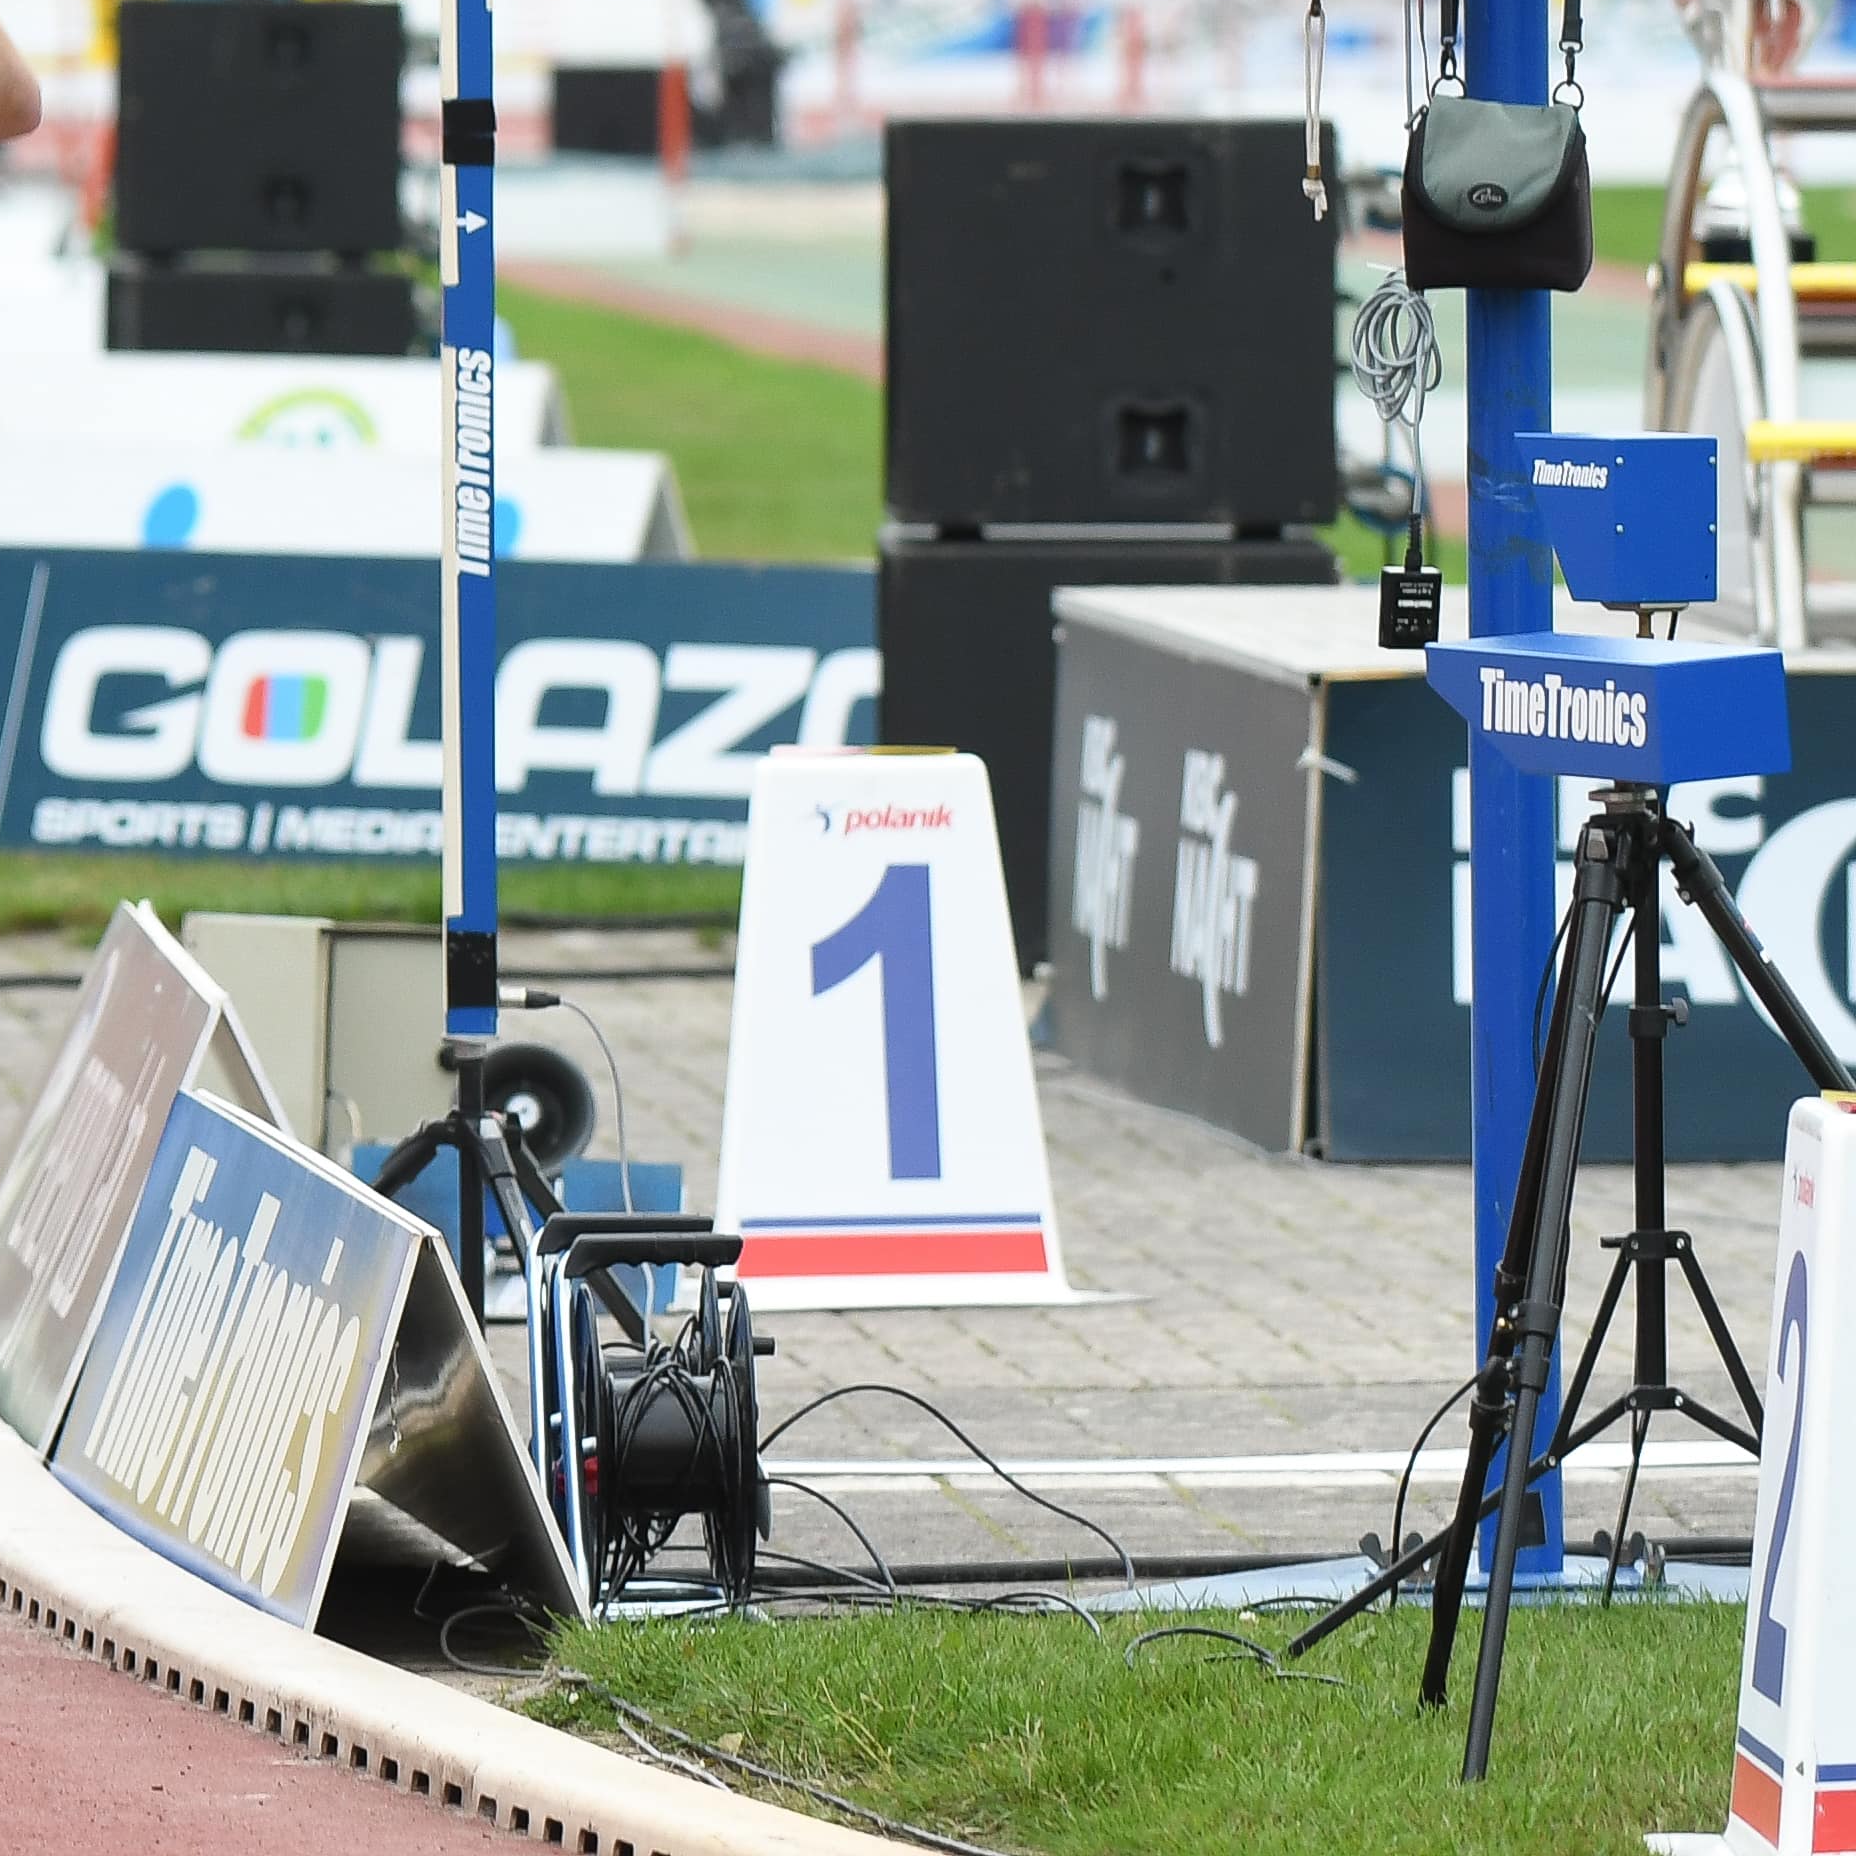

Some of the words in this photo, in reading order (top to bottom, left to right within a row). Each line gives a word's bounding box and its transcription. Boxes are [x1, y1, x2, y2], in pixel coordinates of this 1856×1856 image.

[1532, 457, 1608, 491] TimeTronics
[1479, 666, 1648, 749] TimeTronics
[31, 797, 246, 850] SPORTS
[844, 803, 953, 836] polanik
[811, 863, 942, 1180] 1
[83, 1147, 361, 1599] TimeTronics
[1753, 1249, 1809, 1704] 2
